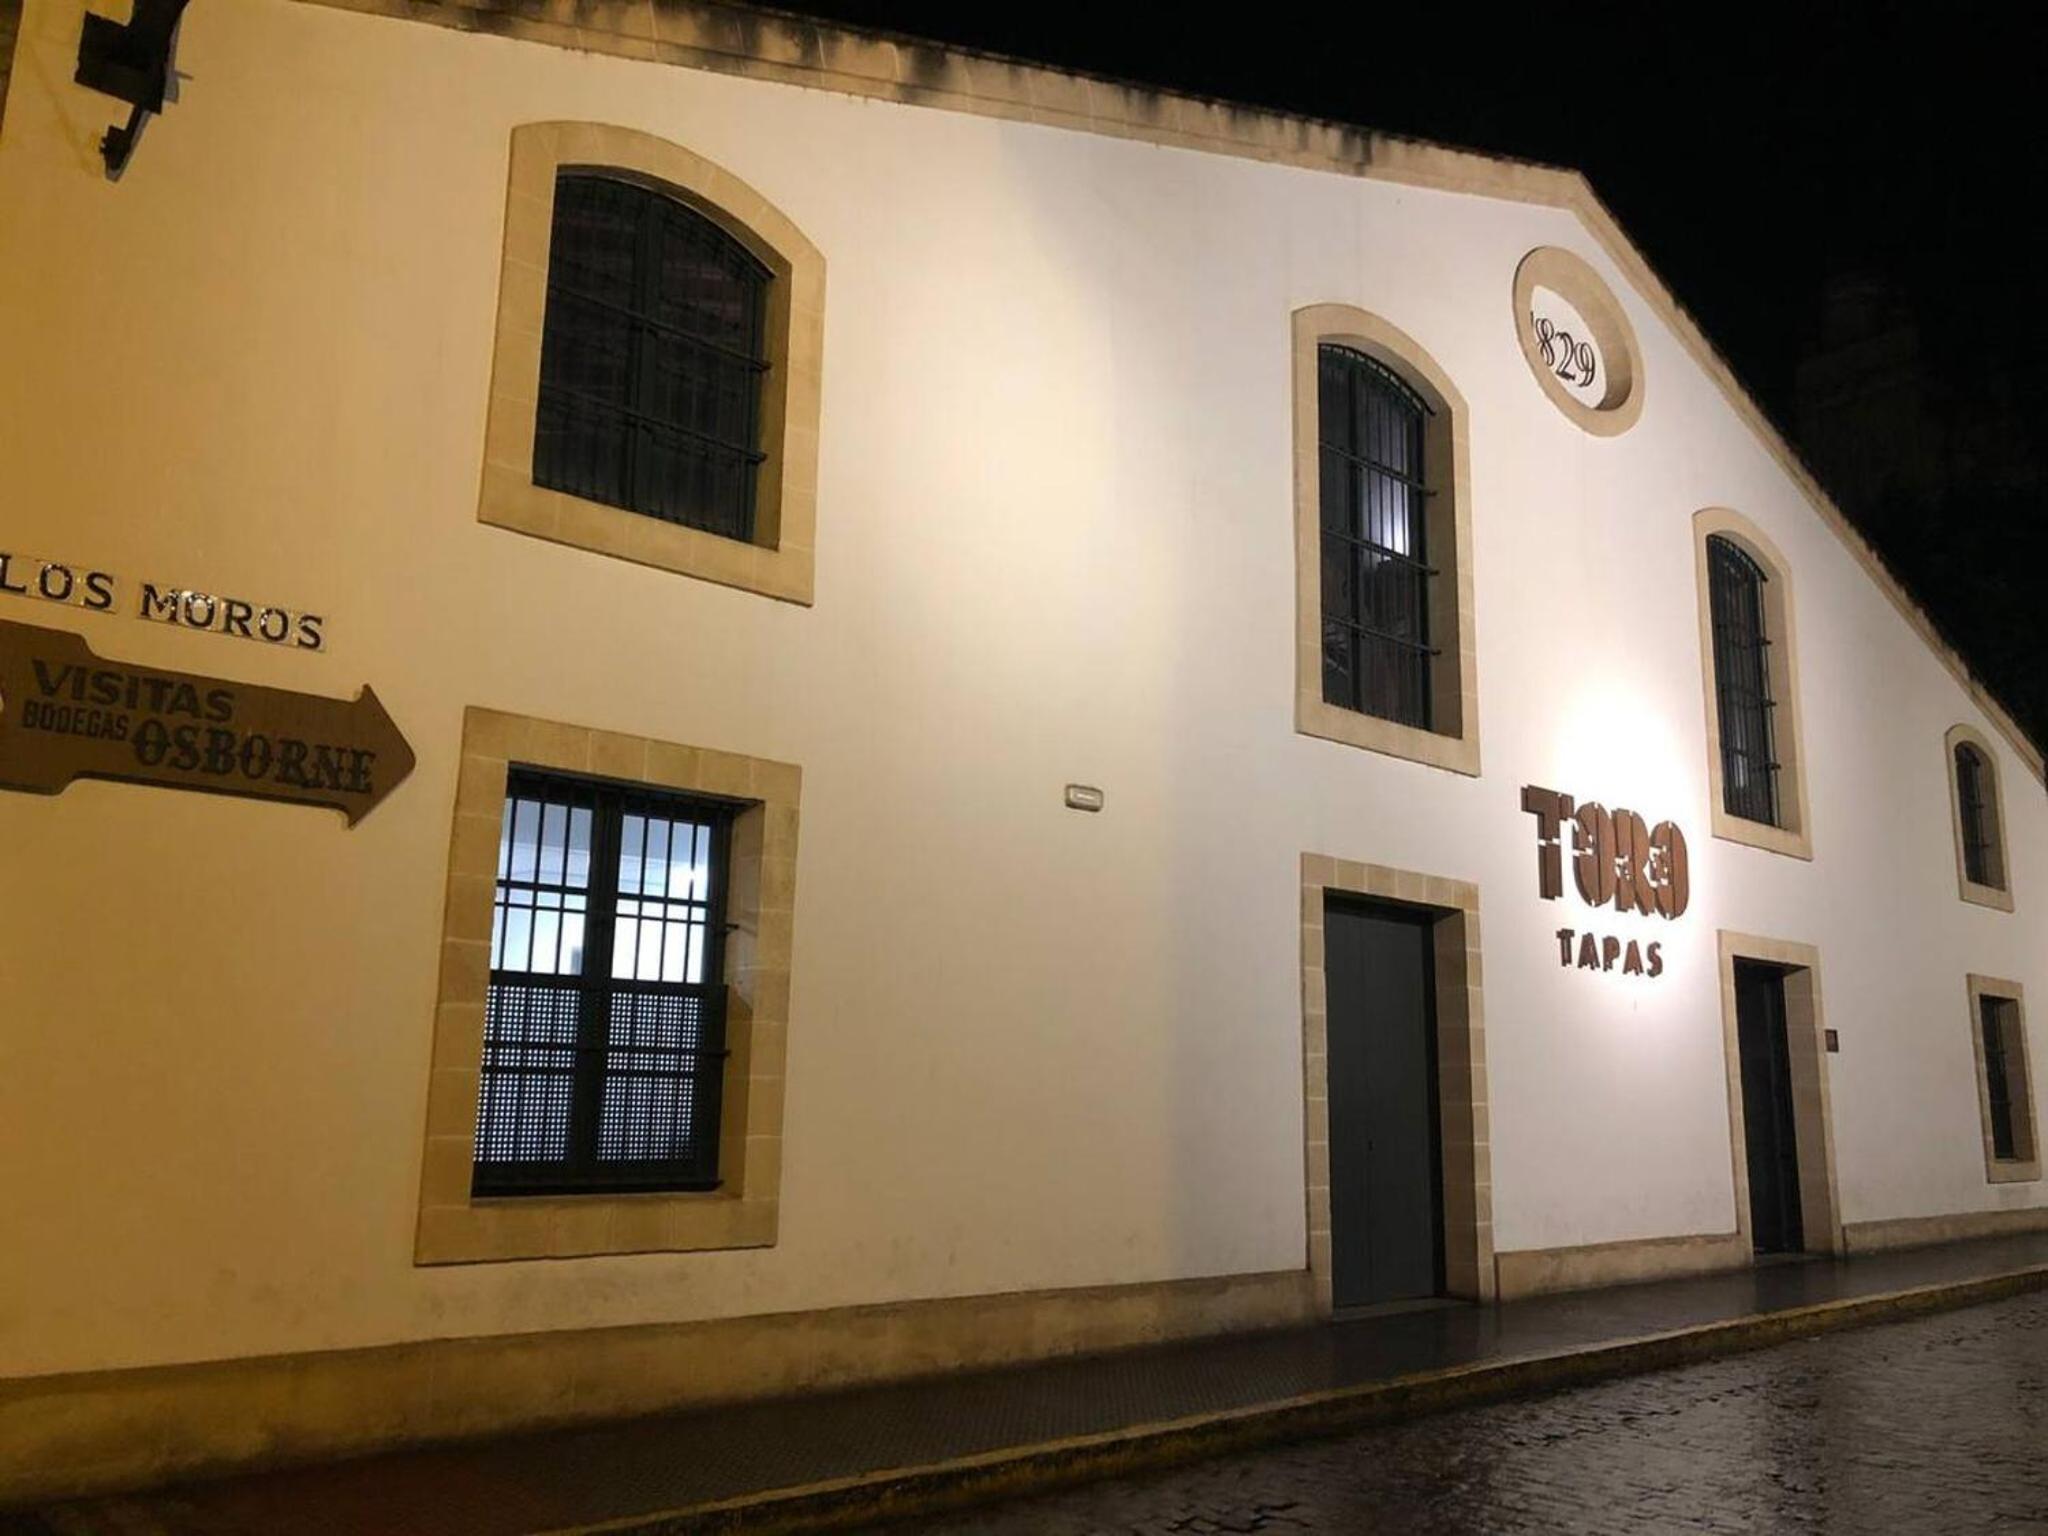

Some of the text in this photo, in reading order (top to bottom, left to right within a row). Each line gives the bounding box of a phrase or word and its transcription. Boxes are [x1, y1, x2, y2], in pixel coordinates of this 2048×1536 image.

[0, 554, 323, 650] LOS MOROS
[32, 658, 237, 723] VISITAS
[22, 702, 376, 794] BODEGAS OSBORNE
[1521, 785, 1689, 920] TORO
[1556, 928, 1663, 978] TAPAS
